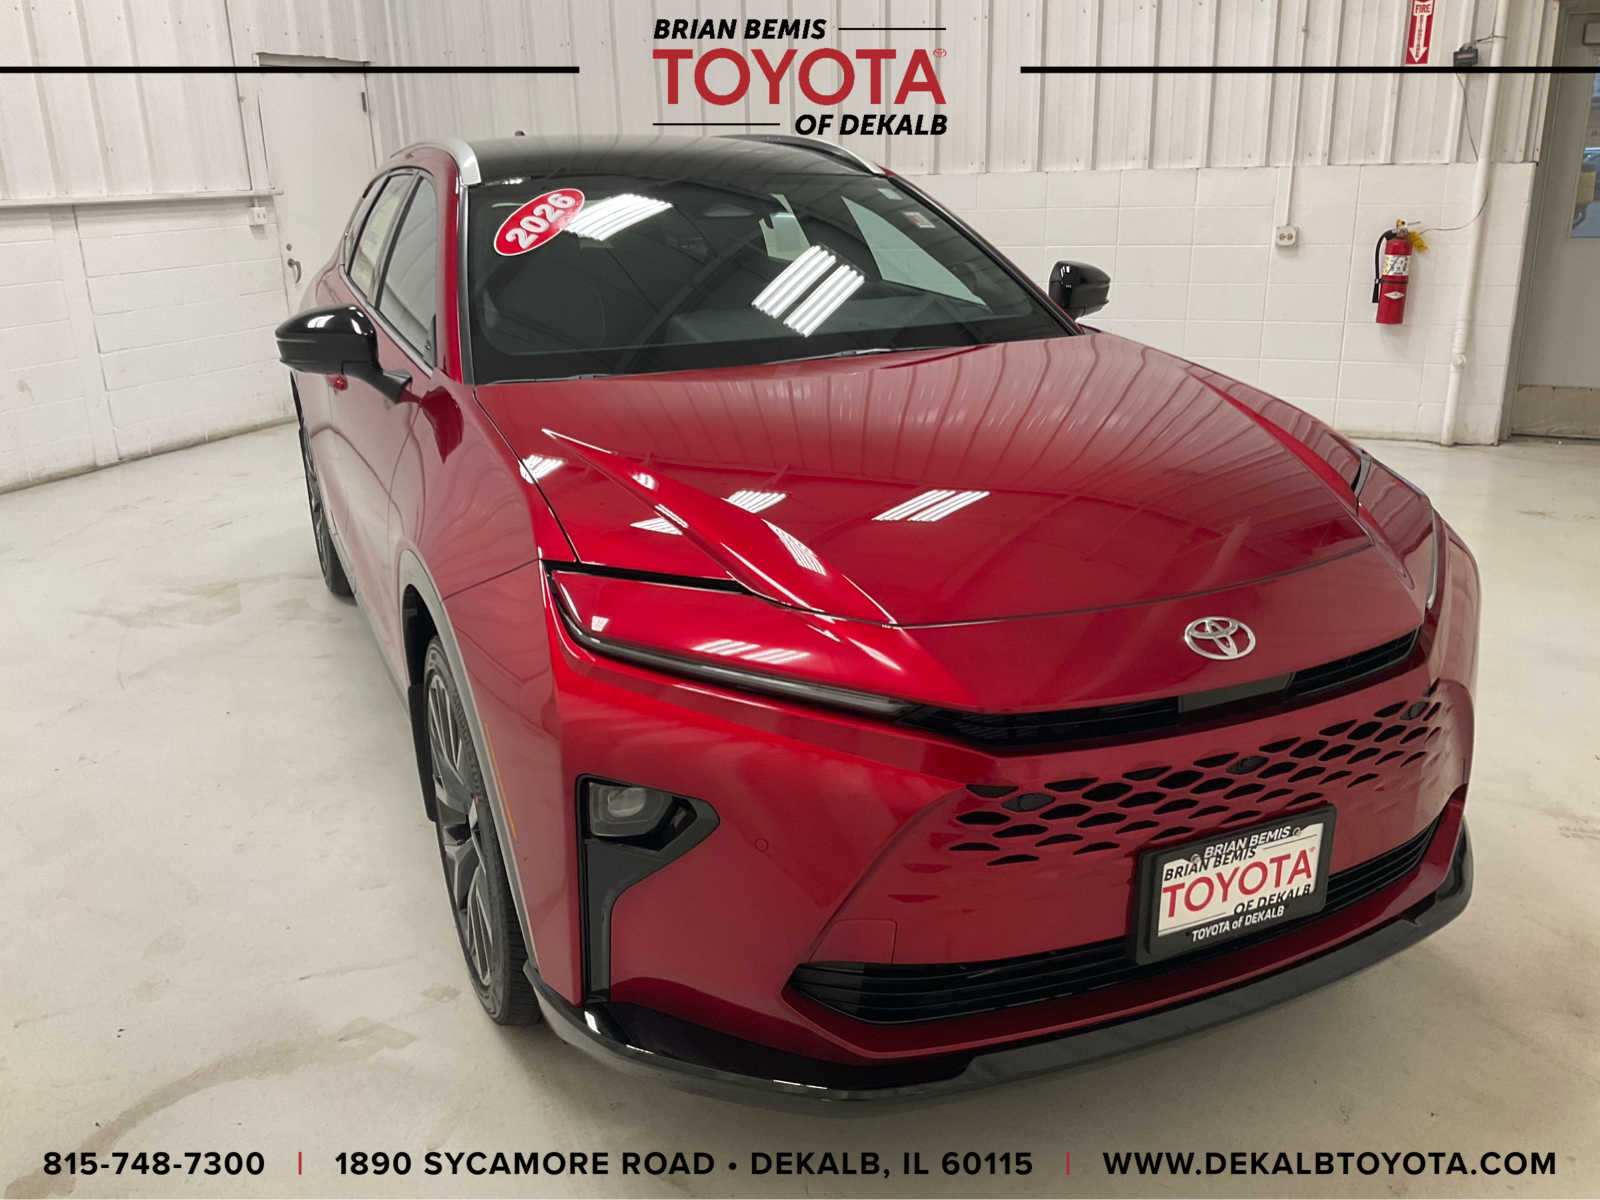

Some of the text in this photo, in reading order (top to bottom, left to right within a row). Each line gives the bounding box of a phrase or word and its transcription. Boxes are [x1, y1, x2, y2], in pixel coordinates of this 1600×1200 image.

[1415, 3, 1431, 14] FIRE
[505, 193, 576, 249] 2026
[1204, 825, 1292, 860] BRIAN BEMIS
[1164, 848, 1257, 882] BRIAN BEMIS
[1163, 849, 1312, 918] TOYOTA
[1234, 884, 1312, 916] OF DEKALB
[1192, 905, 1285, 942] TOYOTA of DEKALB
